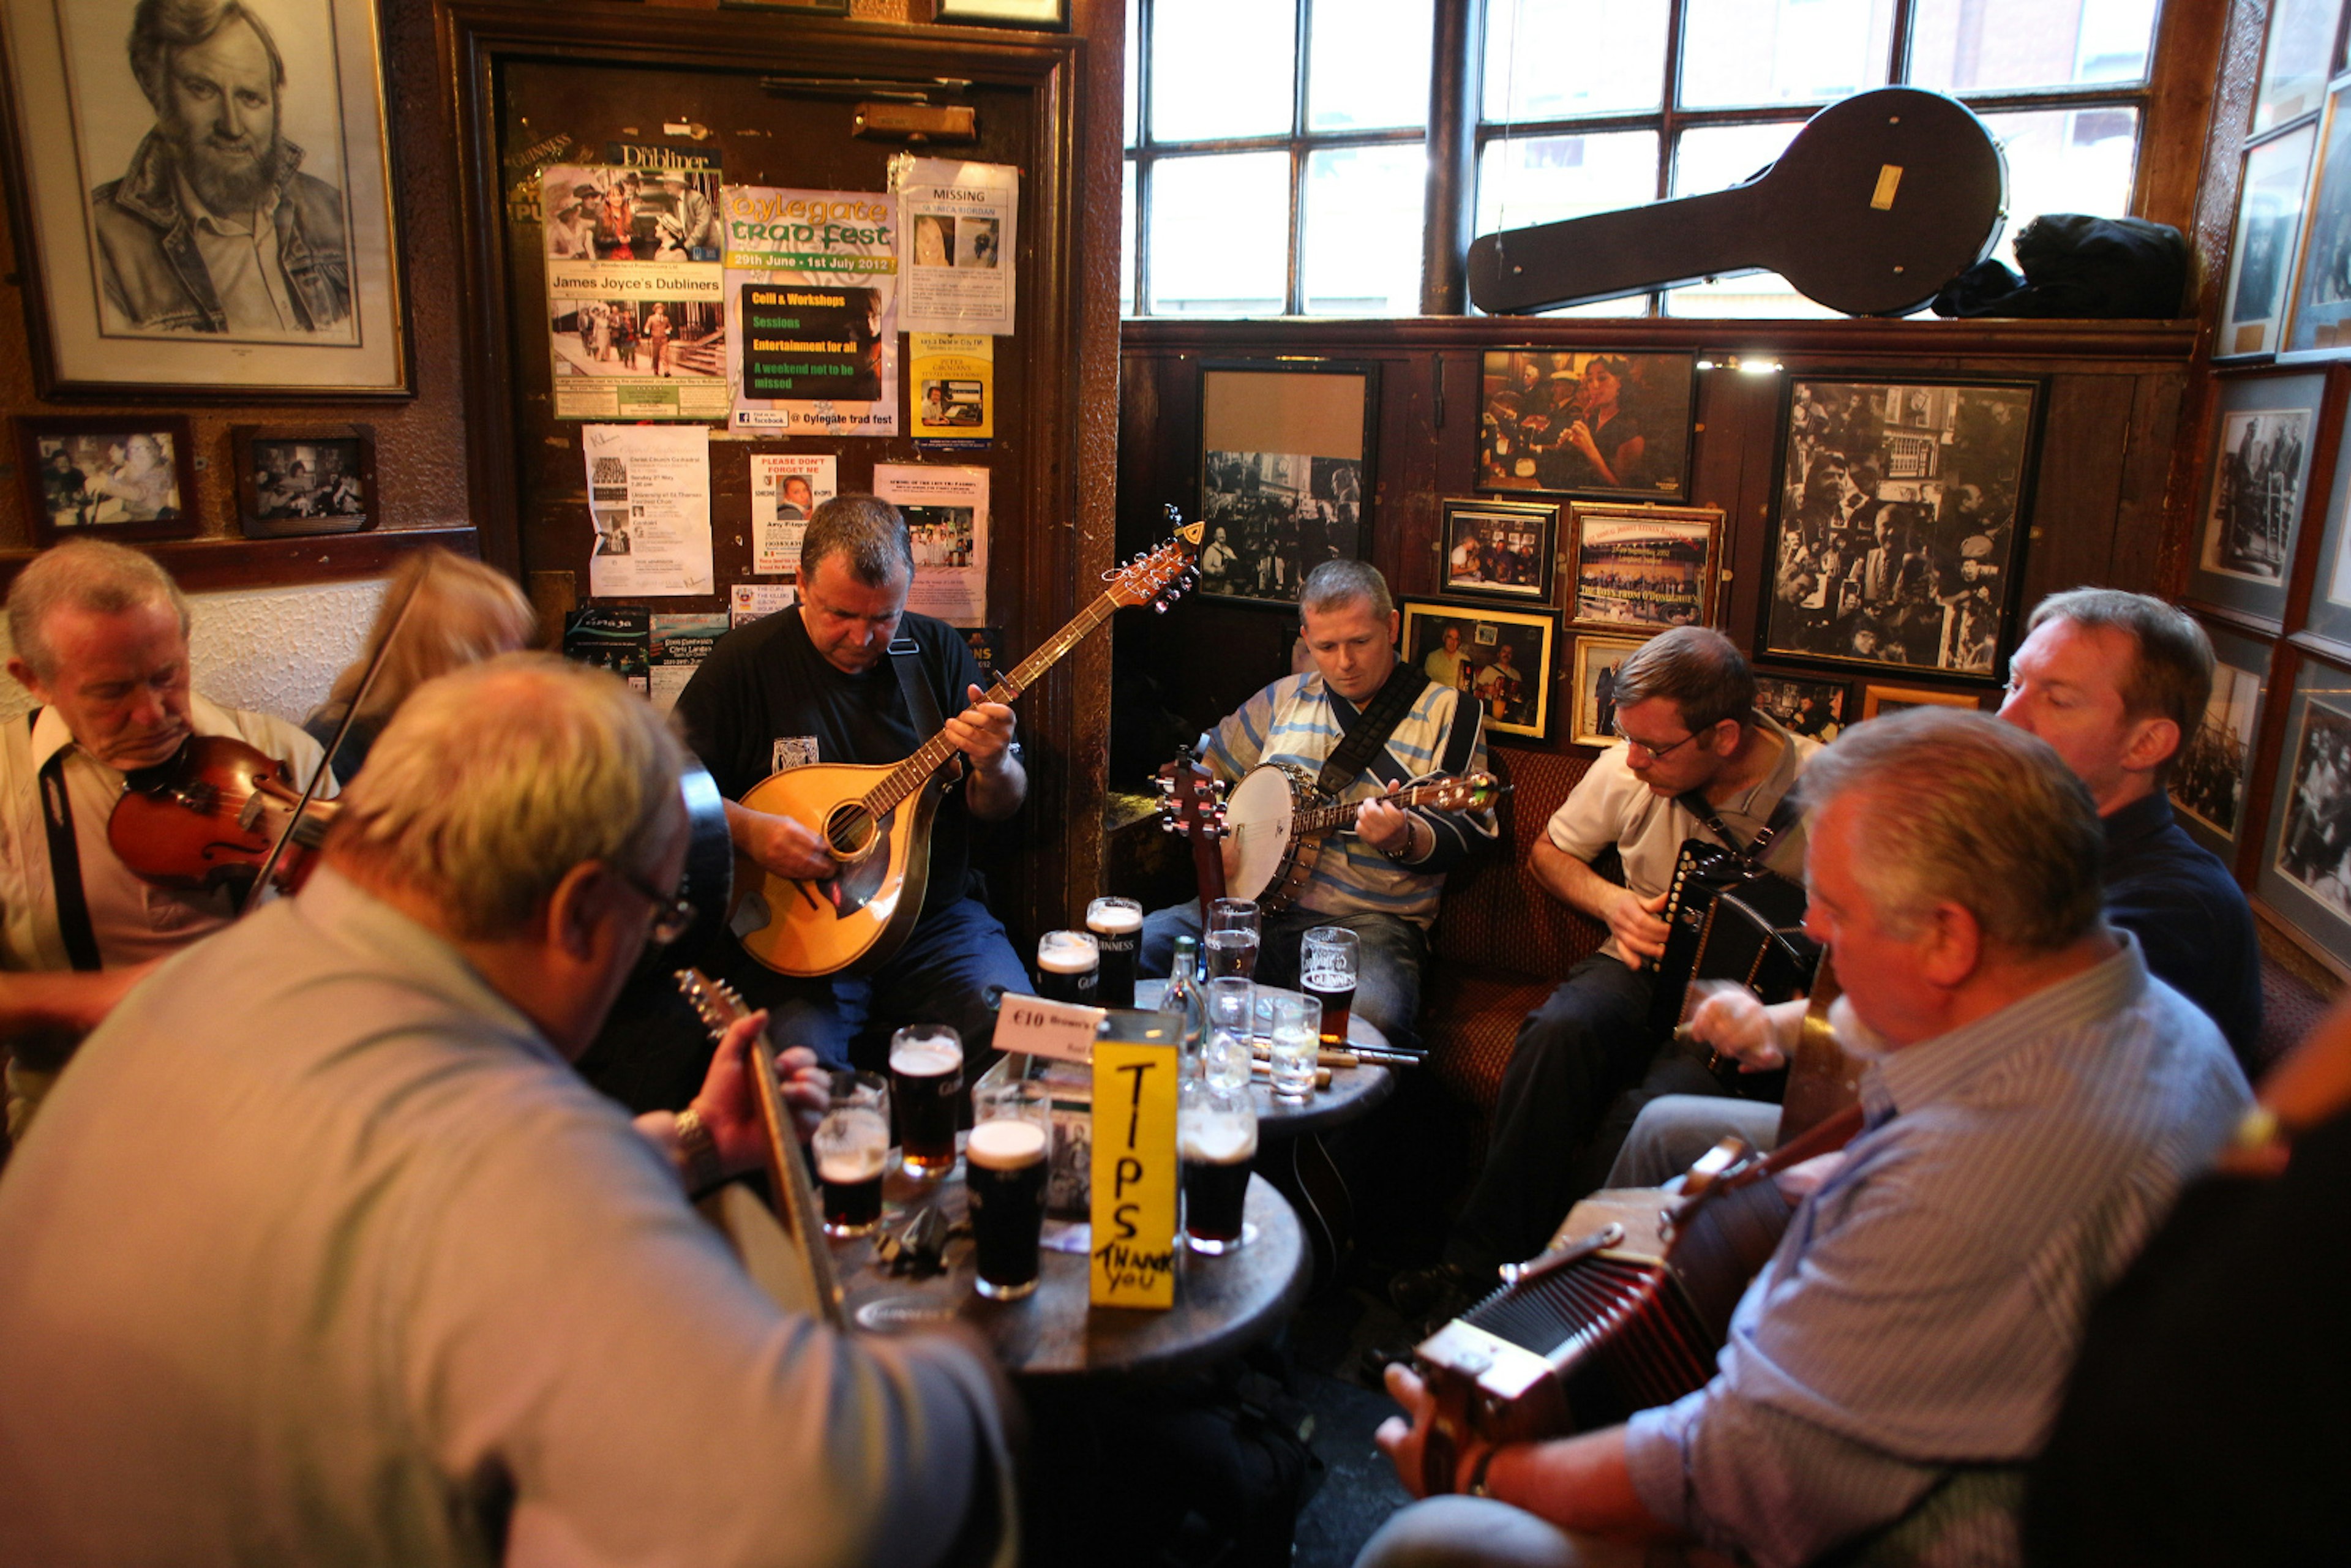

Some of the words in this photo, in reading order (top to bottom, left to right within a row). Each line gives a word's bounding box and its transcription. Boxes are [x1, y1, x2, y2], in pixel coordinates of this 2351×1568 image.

[620, 144, 710, 168] Dubliner
[934, 189, 985, 202] MISSING
[735, 254, 762, 266] 29th
[766, 255, 796, 267] June
[808, 257, 827, 268] 1st
[830, 258, 855, 270] July
[858, 260, 888, 269] 2012
[553, 276, 597, 288] James
[601, 277, 652, 291] Joyce's
[656, 278, 719, 290] Dubliners
[787, 293, 846, 307] Workshops
[753, 316, 800, 329] Sessions
[753, 339, 827, 353] Entertainment
[827, 341, 842, 353] for
[843, 342, 857, 353] all
[754, 362, 762, 374] A
[762, 363, 809, 375] weekend
[811, 364, 827, 375] not
[828, 365, 839, 375] to
[841, 365, 853, 375] be
[754, 378, 792, 389] missed
[804, 414, 847, 424] Oylegate
[850, 415, 870, 424] trad
[874, 415, 892, 424] fest
[972, 648, 991, 659] NS
[1098, 940, 1134, 951] UINNESS
[1013, 1008, 1044, 1027] €10
[1115, 1062, 1156, 1239] TIPS
[1095, 1241, 1174, 1274] THANK
